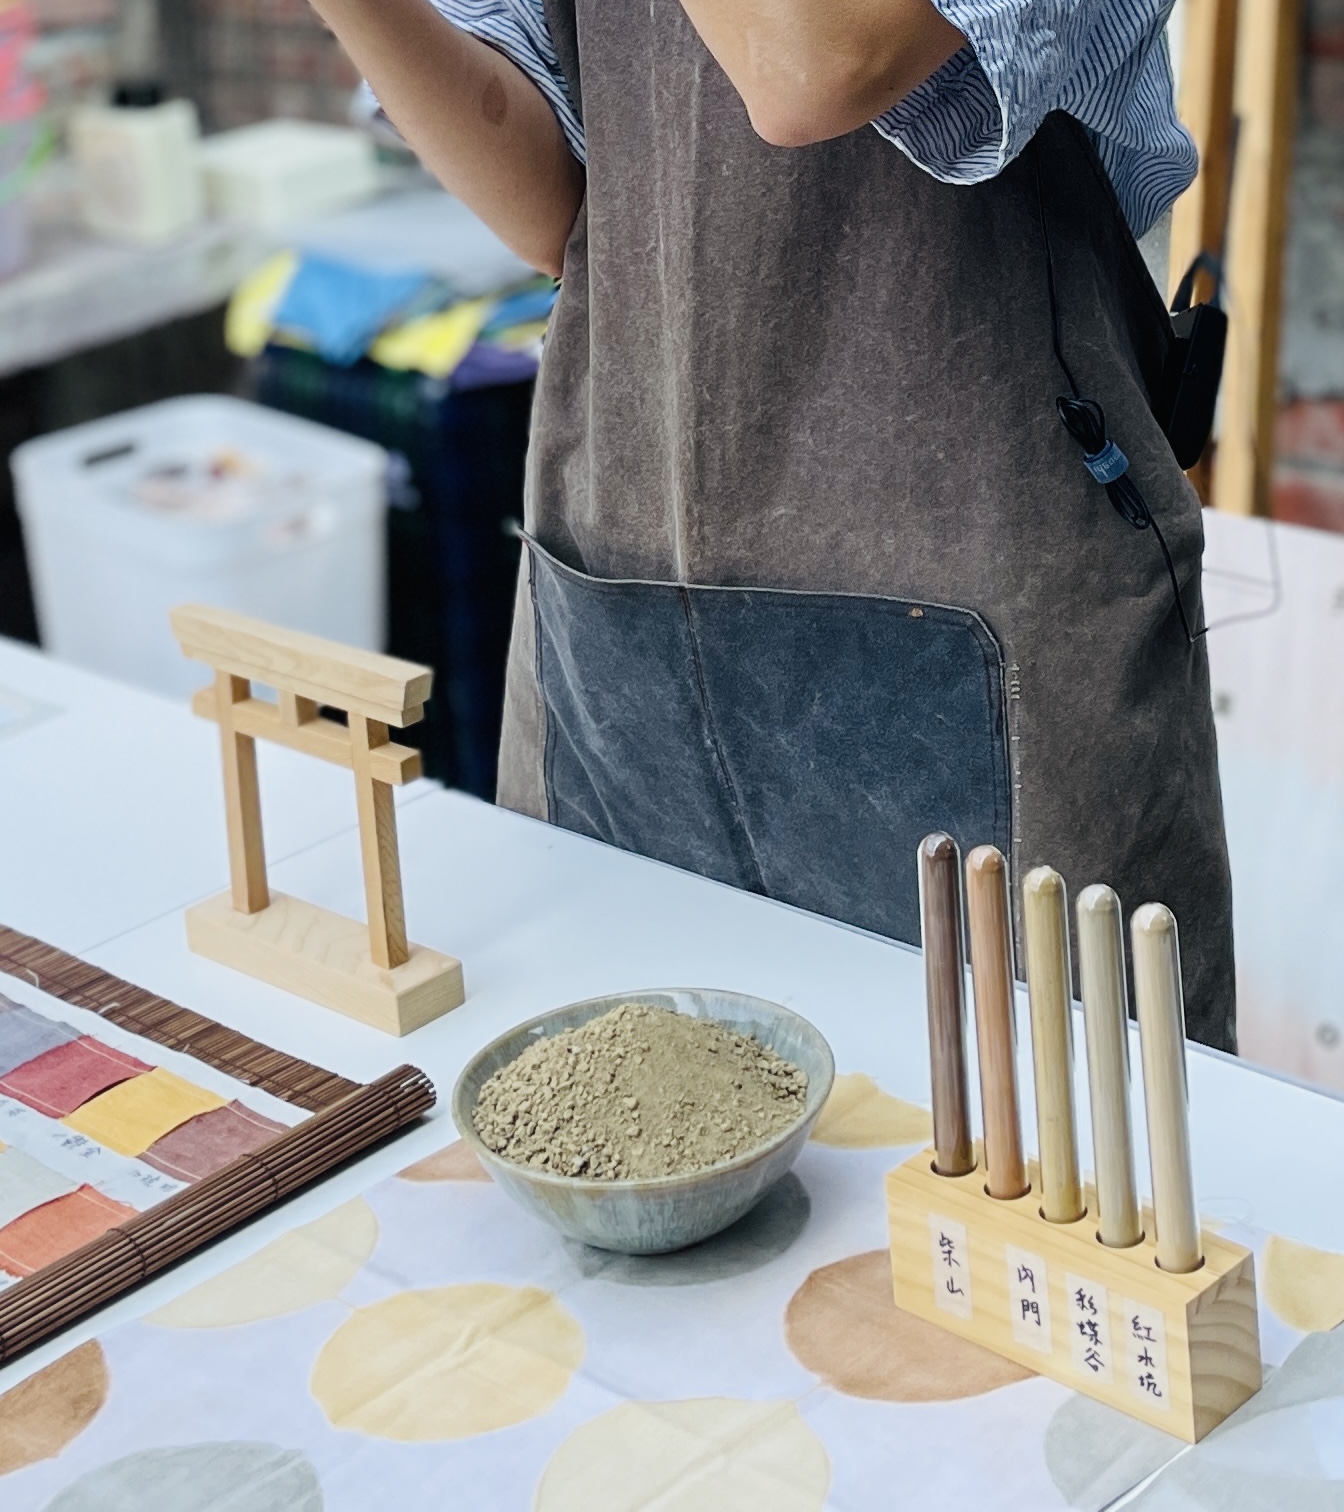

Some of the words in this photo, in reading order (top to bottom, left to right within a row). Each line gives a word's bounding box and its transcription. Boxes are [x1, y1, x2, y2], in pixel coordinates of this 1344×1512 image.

[938, 1231, 964, 1296] 柴山
[1075, 1288, 1105, 1373] 彩蝶谷
[1131, 1314, 1163, 1398] 紅水坑
